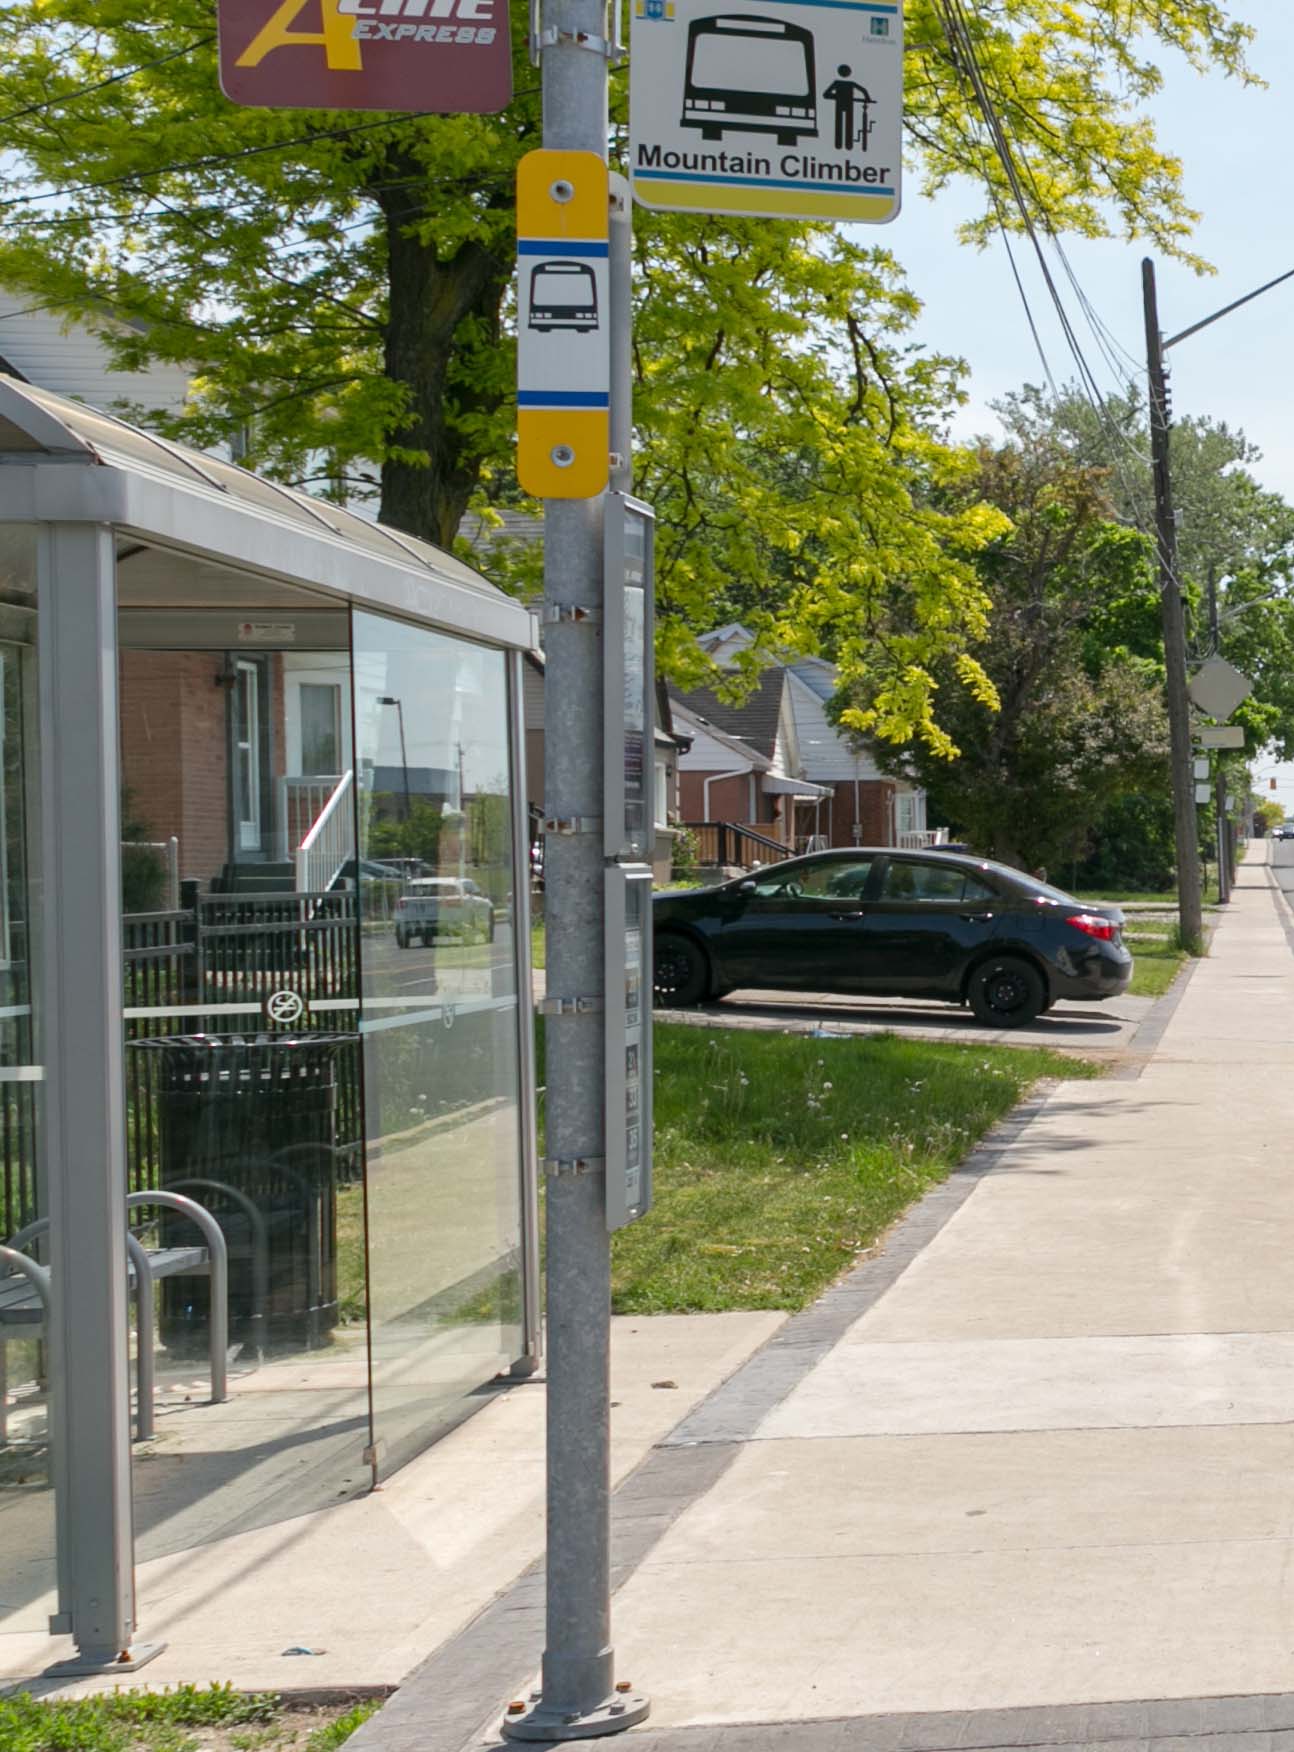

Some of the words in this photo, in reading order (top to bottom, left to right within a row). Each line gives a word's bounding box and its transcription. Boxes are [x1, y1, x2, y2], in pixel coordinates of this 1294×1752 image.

[351, 19, 496, 45] EXPRESS
[637, 143, 771, 176] Mountain
[780, 154, 891, 184] Climber
